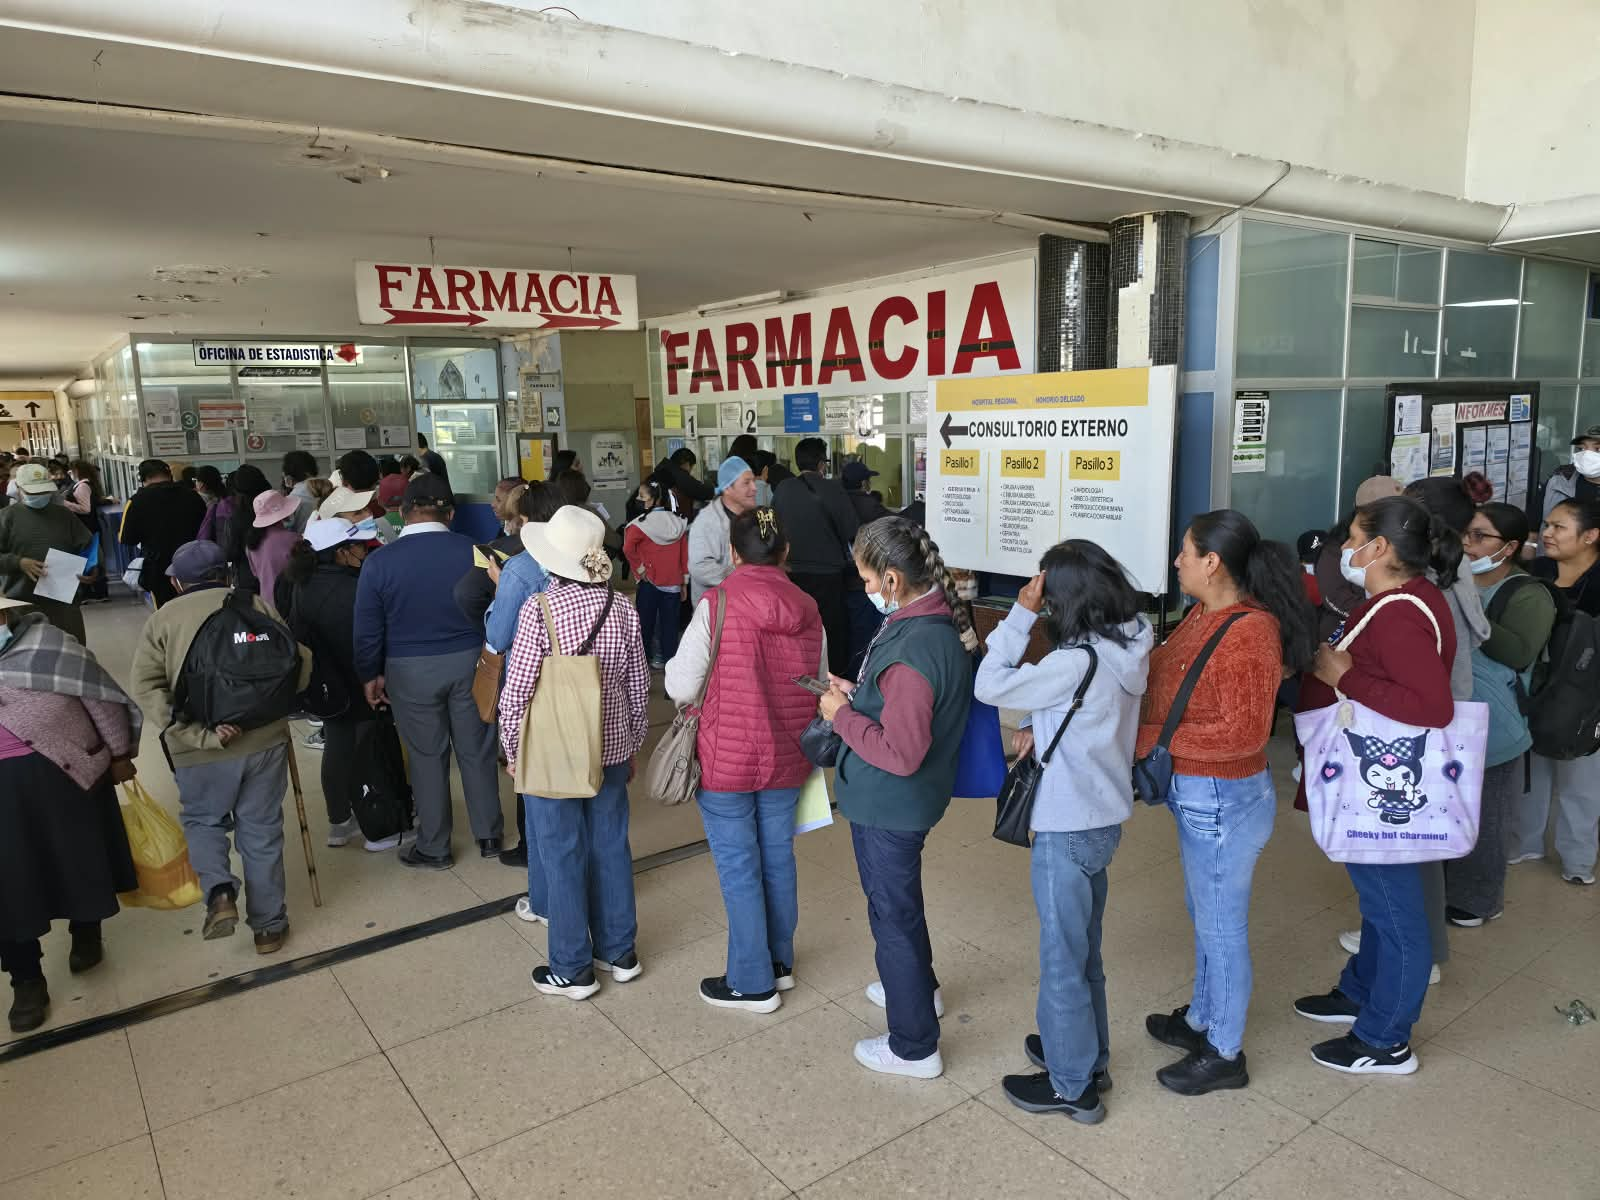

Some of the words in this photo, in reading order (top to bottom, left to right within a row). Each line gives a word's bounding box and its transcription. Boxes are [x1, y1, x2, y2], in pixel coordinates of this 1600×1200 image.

[374, 264, 622, 316] FARMACIA
[664, 280, 1022, 396] FARMACIA
[199, 346, 246, 361] OFICINA
[249, 347, 264, 361] DE
[266, 347, 335, 361] ESTADISTICA
[1060, 394, 1085, 403] DELGADO
[688, 415, 695, 437] 1
[745, 409, 757, 433] 2
[968, 420, 1057, 438] CONSULTORIO
[1061, 418, 1129, 438] EXTERNO
[945, 456, 969, 469] Pasillo
[1005, 456, 1032, 470] Pasillo
[1033, 456, 1039, 470] 2
[1075, 456, 1106, 471] Pasillo
[1107, 457, 1114, 471] 3
[1346, 829, 1380, 840] Cheeky
[1381, 831, 1398, 840] but
